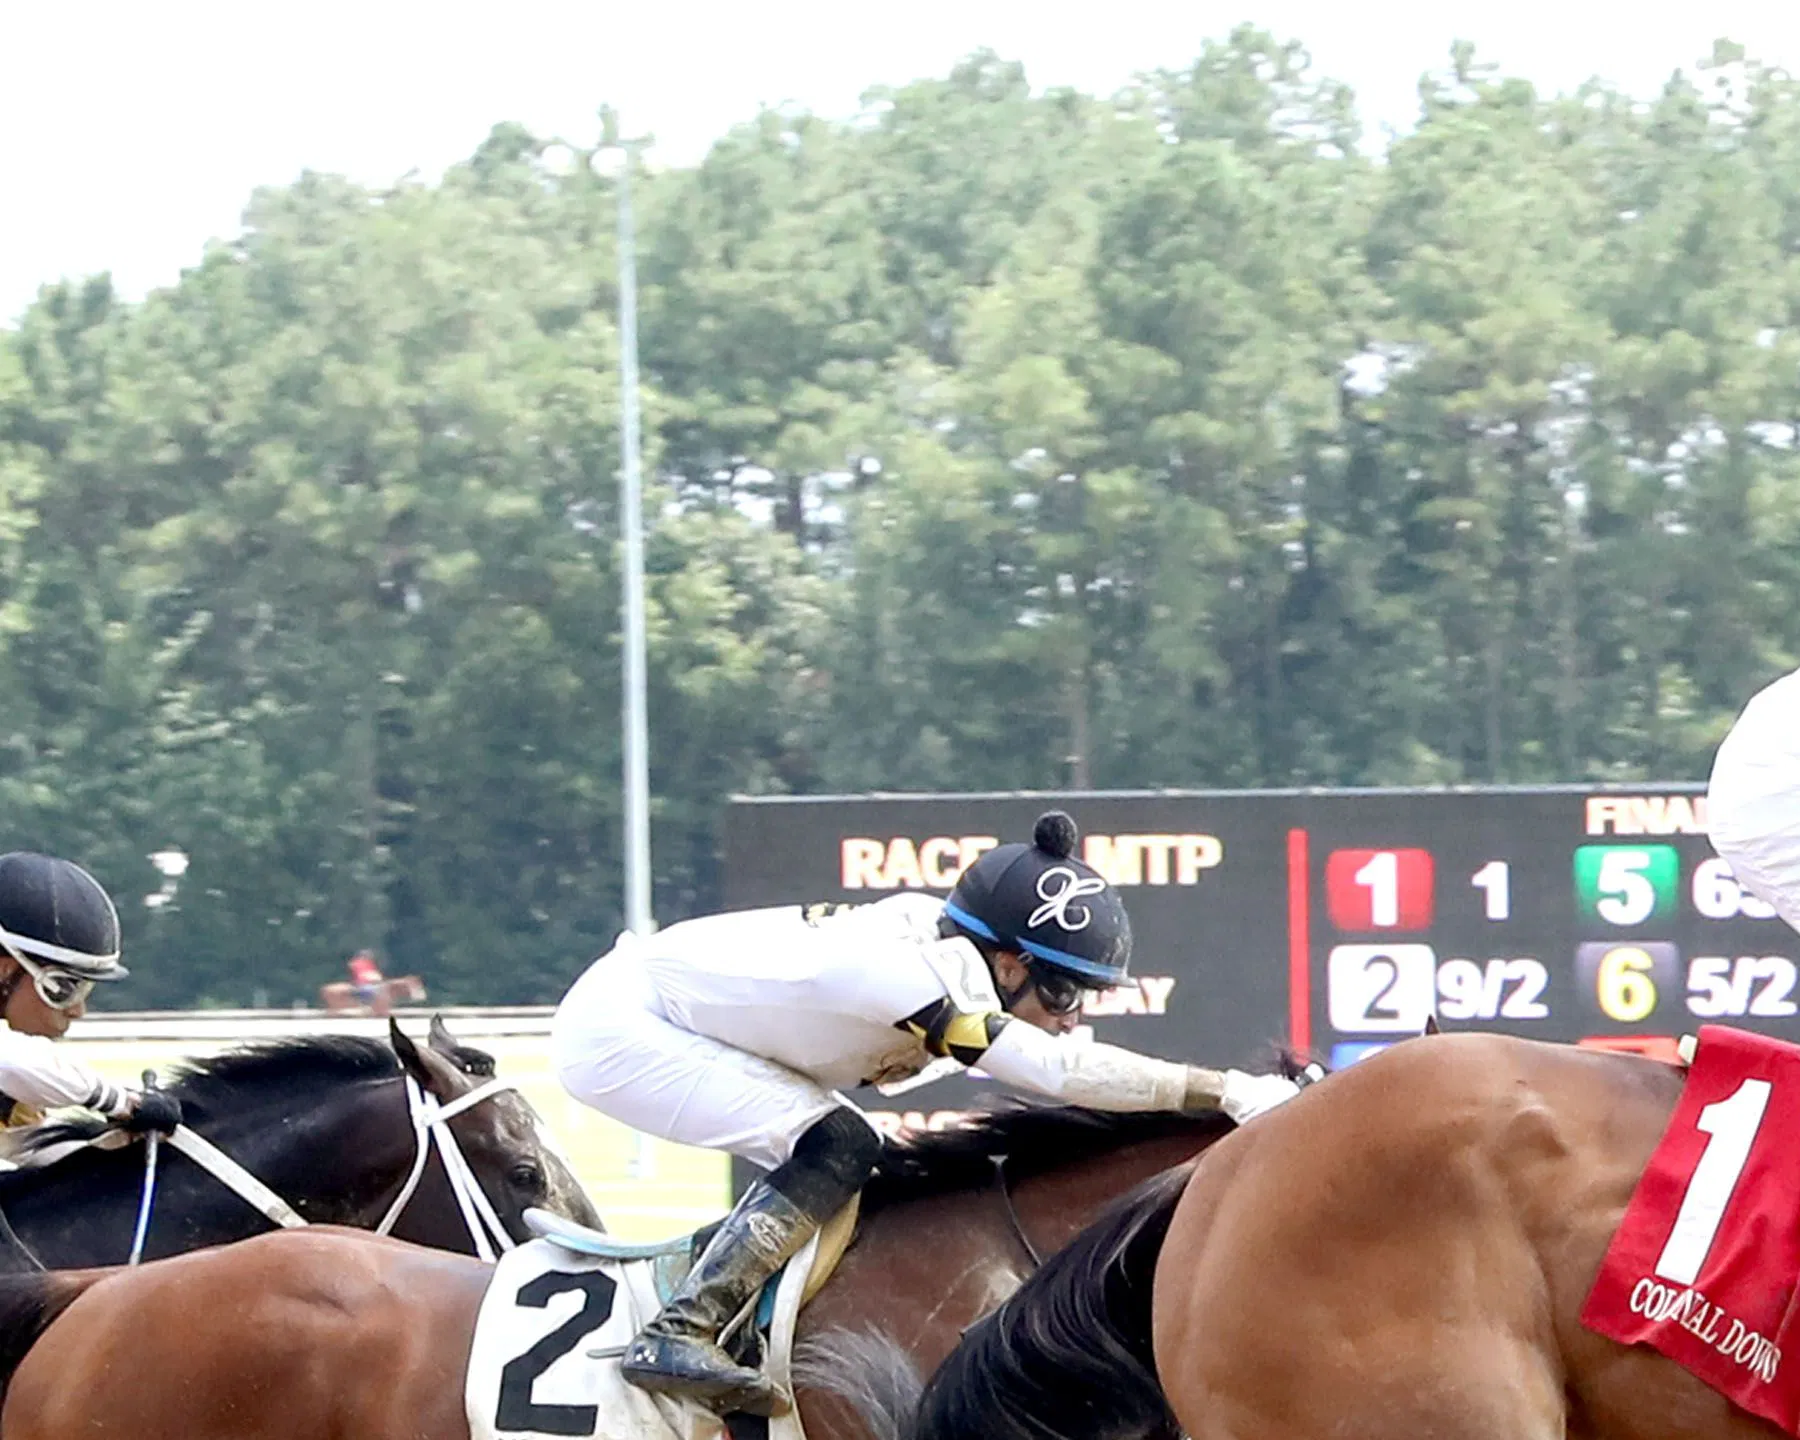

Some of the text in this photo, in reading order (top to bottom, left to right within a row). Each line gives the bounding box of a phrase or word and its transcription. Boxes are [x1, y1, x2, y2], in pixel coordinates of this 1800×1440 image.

[1354, 851, 1399, 927] 1
[1471, 860, 1510, 920] 1
[1596, 850, 1656, 926] 5
[1362, 954, 1401, 1021] 2
[1436, 958, 1549, 1020] 9/2
[1598, 946, 1658, 1022] 6
[1686, 956, 1799, 1018] 5/2
[1654, 1077, 1773, 1286] 1
[495, 1269, 618, 1437] 2
